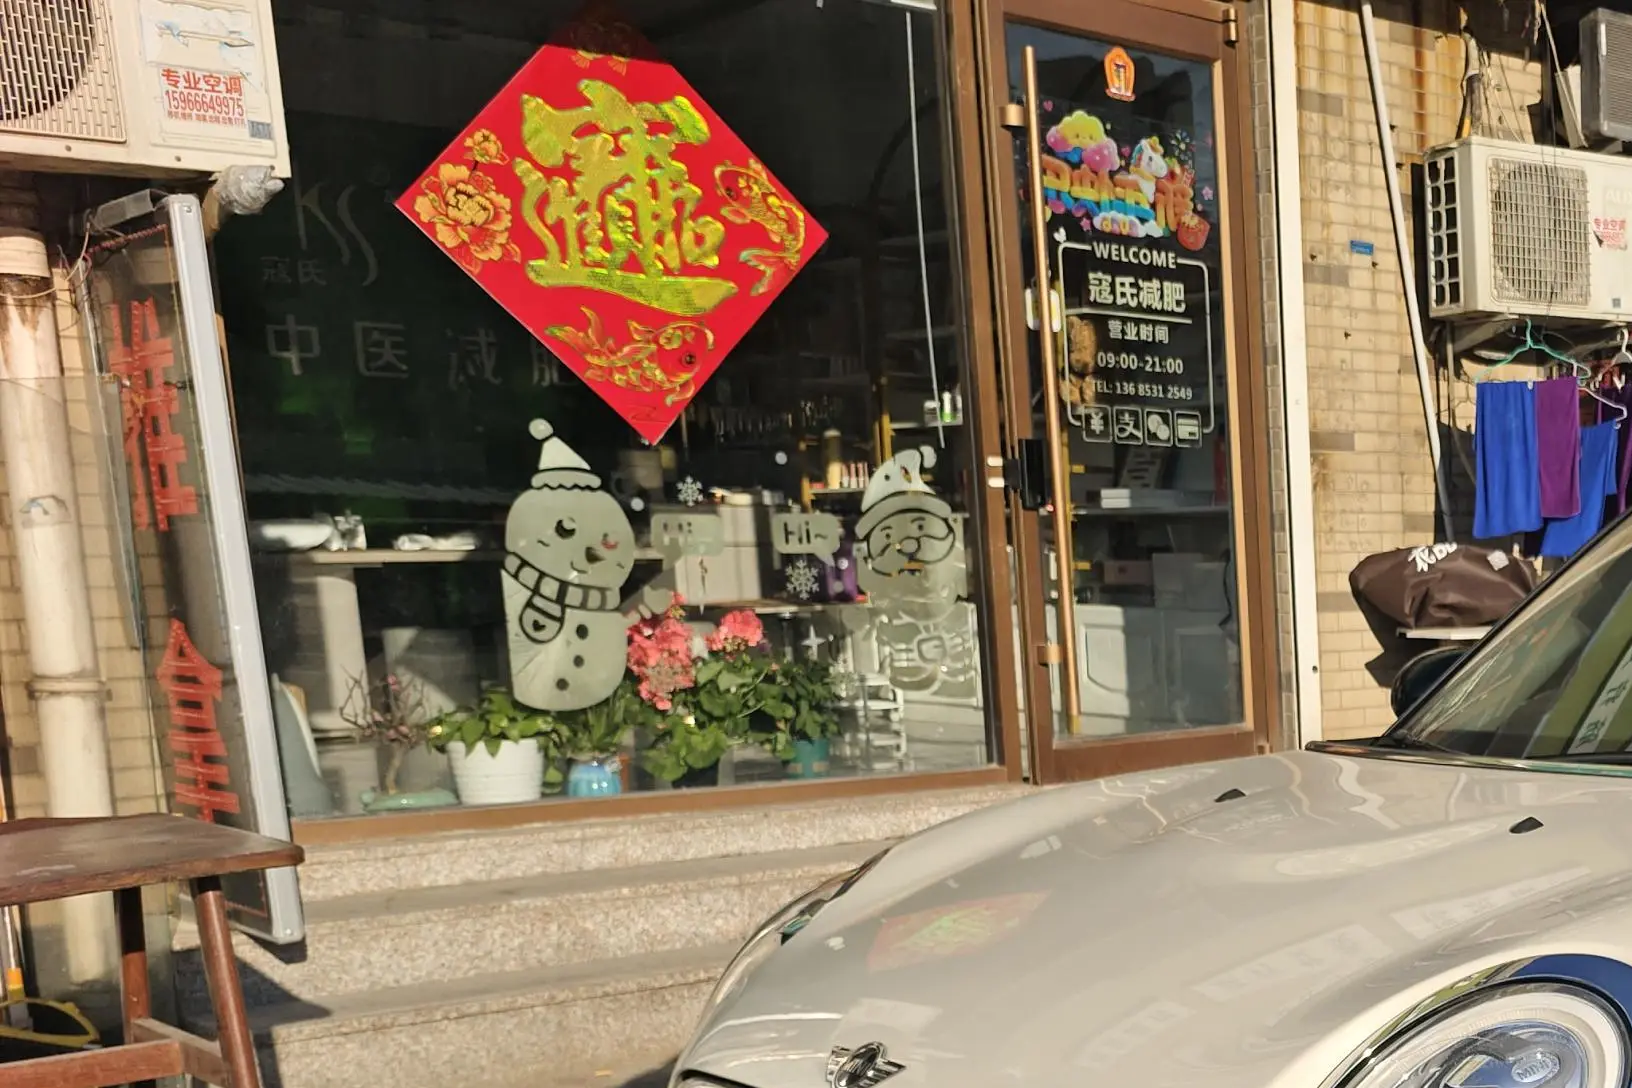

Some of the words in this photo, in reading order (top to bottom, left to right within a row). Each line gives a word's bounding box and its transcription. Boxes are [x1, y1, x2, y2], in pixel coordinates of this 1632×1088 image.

[161, 68, 244, 97] 专业空调
[165, 89, 245, 118] 15966649975
[1093, 242, 1177, 269] WELCOME
[1087, 271, 1187, 314] 寇氏减肥
[1108, 319, 1170, 345] 营业时间
[1097, 351, 1184, 375] 09:00-21:00
[1115, 382, 1136, 396] 136
[1138, 384, 1165, 399] 8531
[1167, 387, 1194, 401] 2549
[1515, 1059, 1550, 1081] MINI
